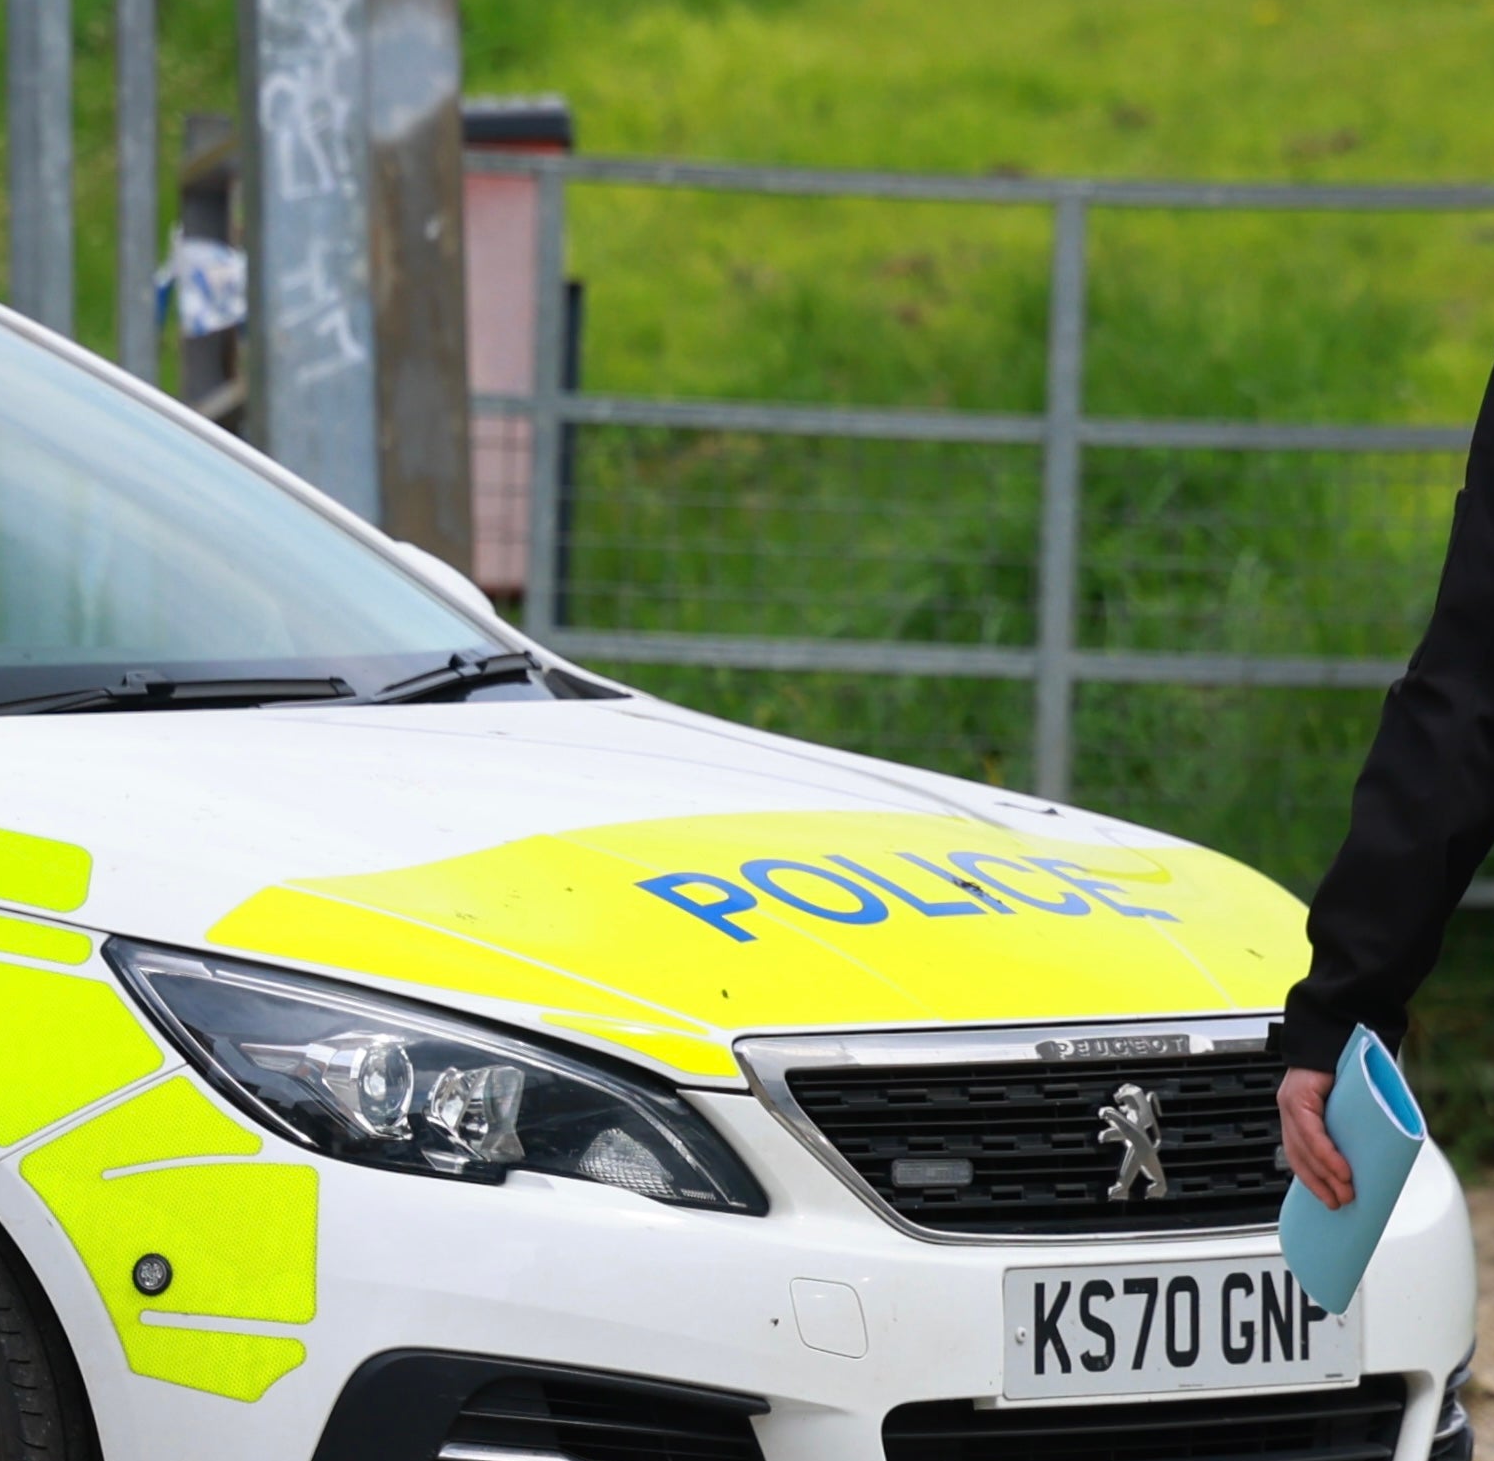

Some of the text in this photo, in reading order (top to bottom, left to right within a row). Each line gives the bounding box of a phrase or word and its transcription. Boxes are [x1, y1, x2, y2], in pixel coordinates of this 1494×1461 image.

[634, 851, 1183, 943] POLICE
[1052, 1038, 1184, 1060] PEUGEOT
[1034, 1275, 1200, 1375] KS70
